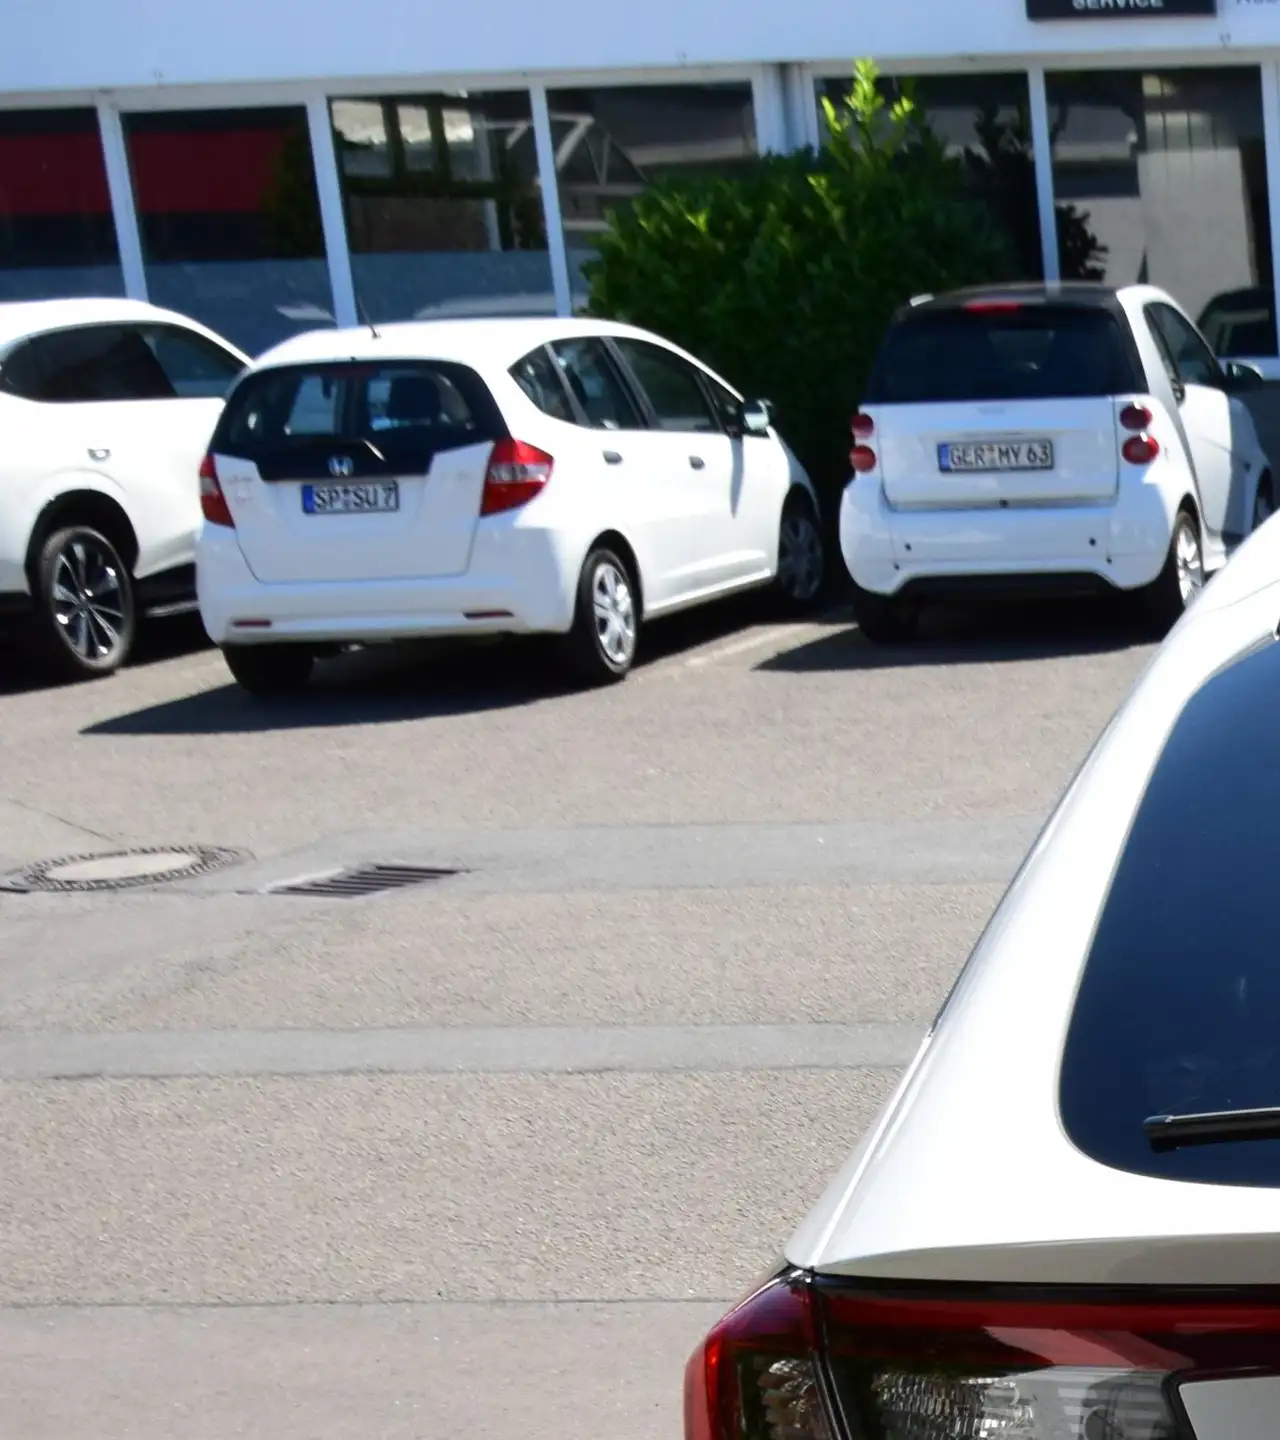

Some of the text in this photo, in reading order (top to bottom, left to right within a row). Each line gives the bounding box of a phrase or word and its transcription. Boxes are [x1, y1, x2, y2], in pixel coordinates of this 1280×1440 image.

[950, 443, 1050, 466] GER MY 63
[313, 487, 340, 510] SP
